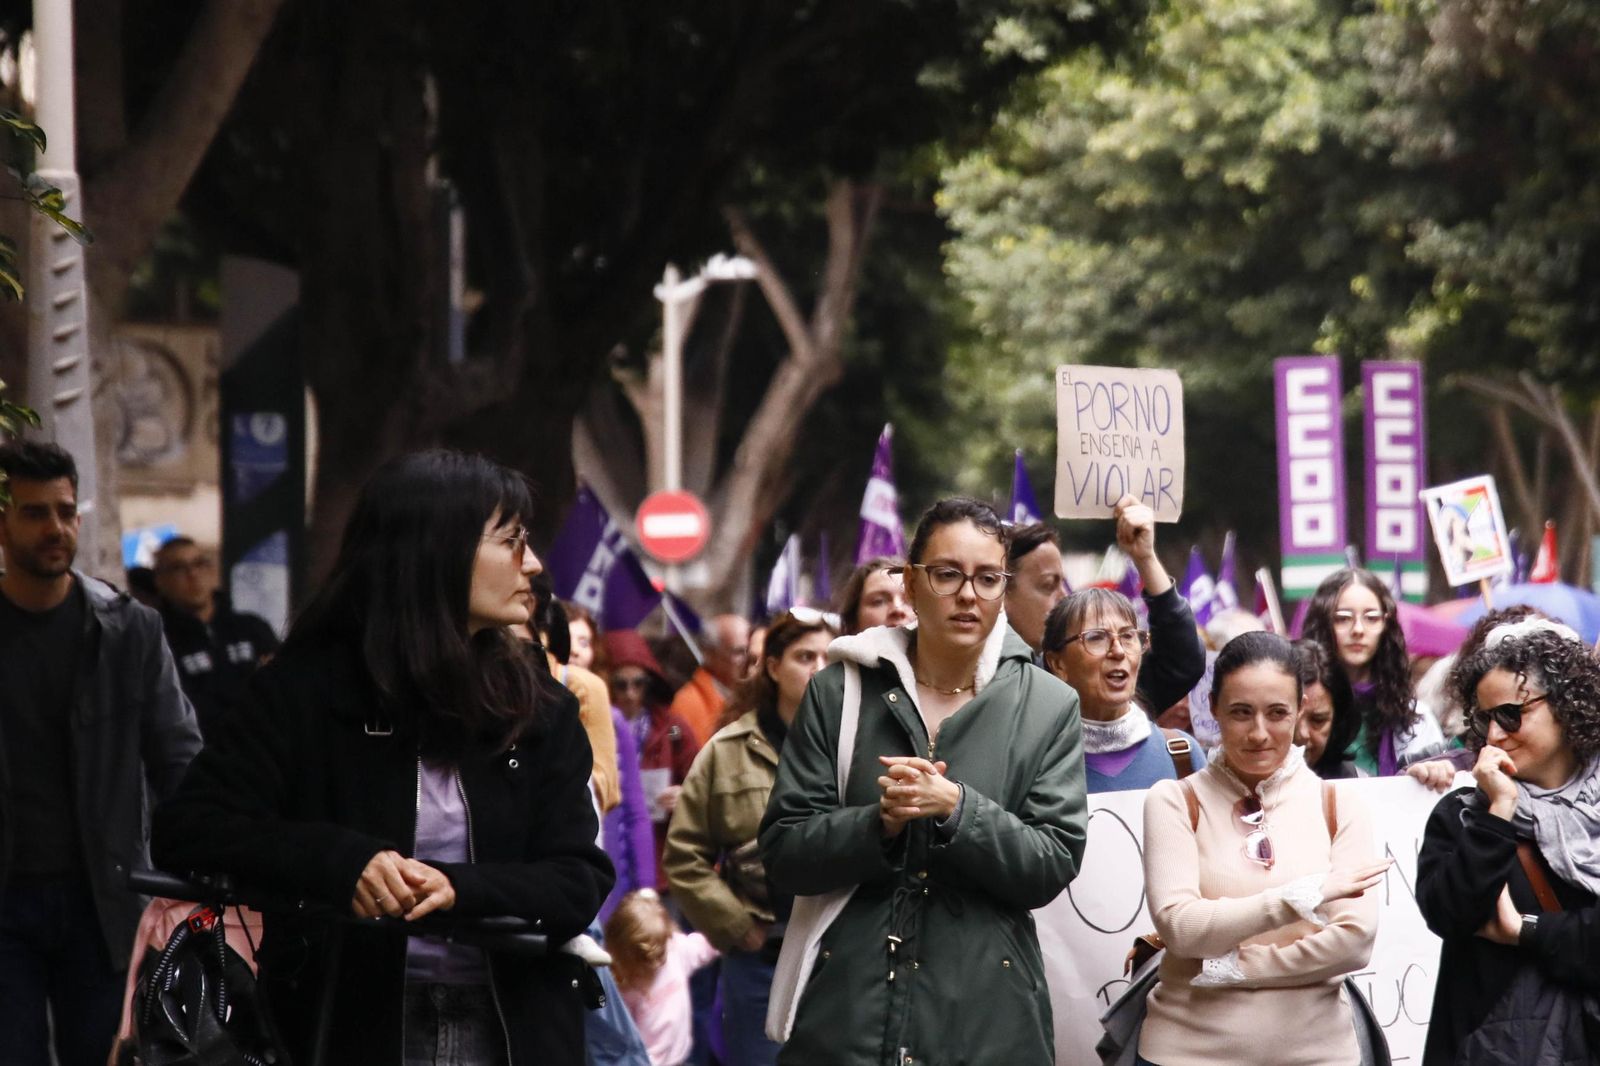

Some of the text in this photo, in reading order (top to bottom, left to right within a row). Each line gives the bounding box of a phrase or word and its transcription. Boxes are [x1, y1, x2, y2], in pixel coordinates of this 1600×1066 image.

[1062, 371, 1073, 386] EL
[1074, 381, 1171, 436] PORNO
[1151, 439, 1161, 461] A
[1286, 367, 1335, 547] CCOO
[1372, 371, 1416, 552] CCOO
